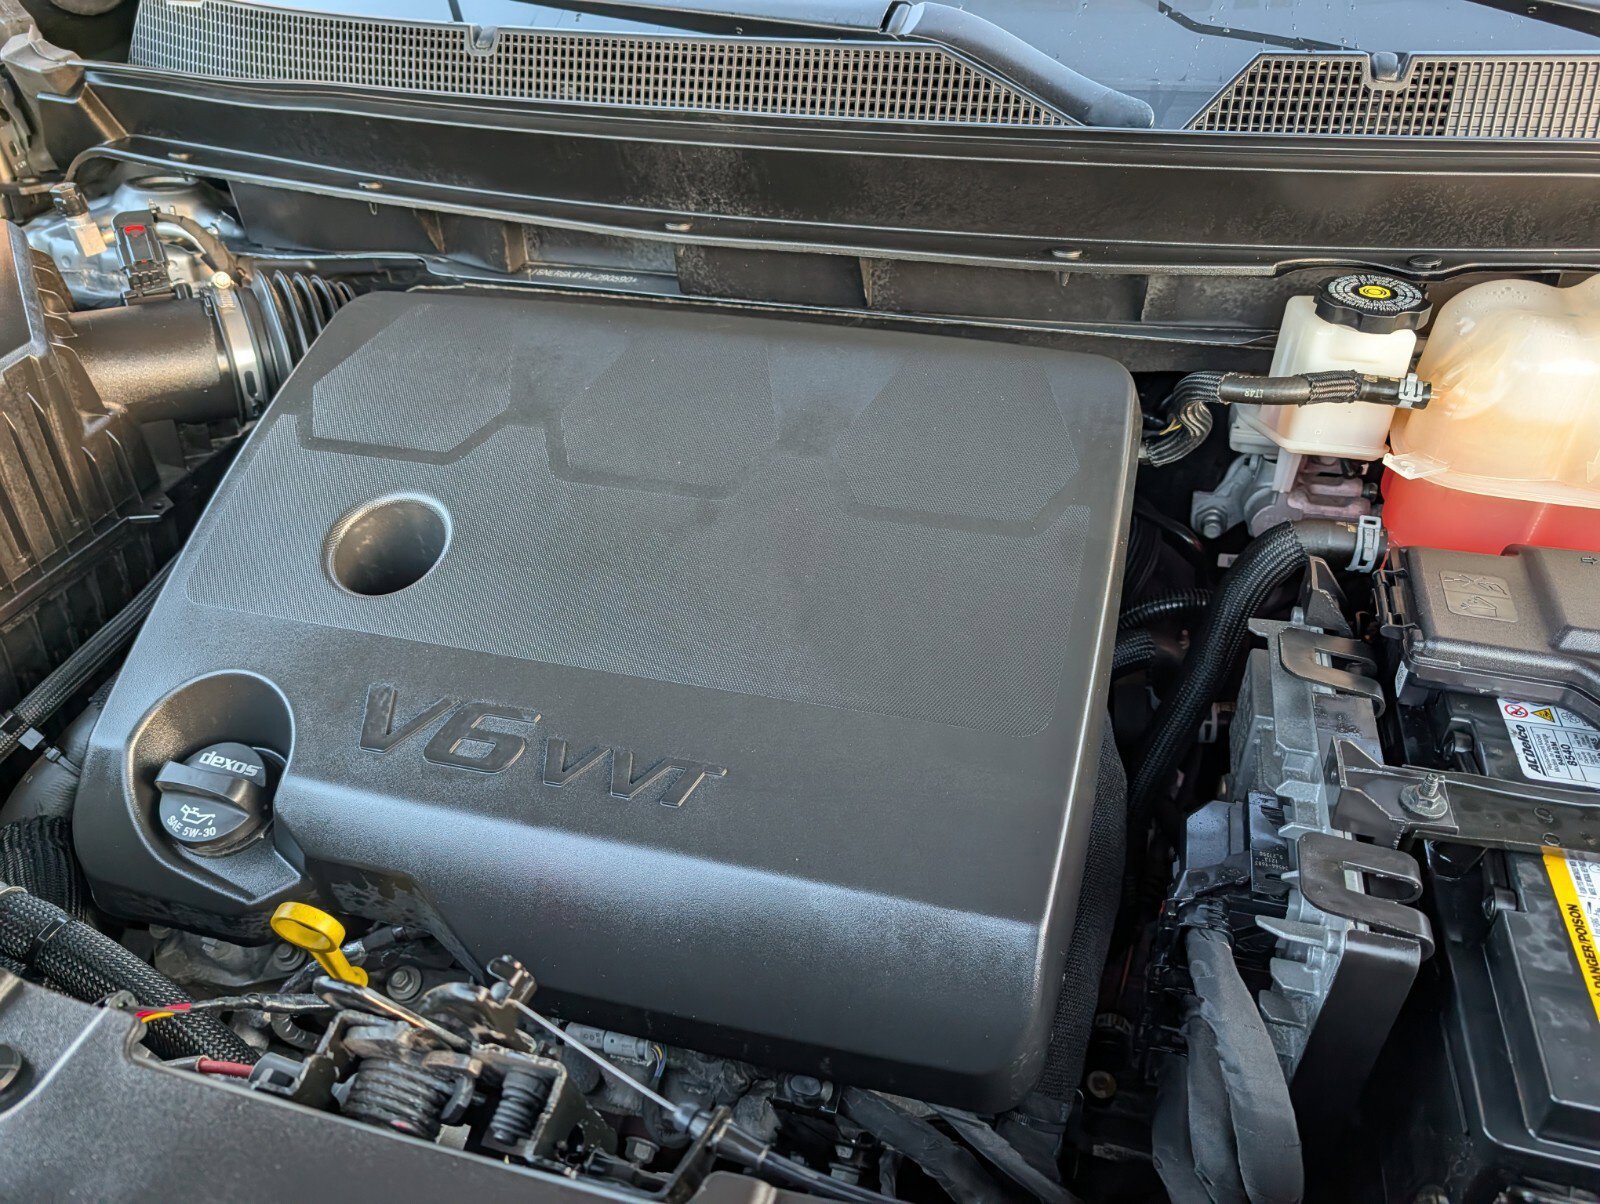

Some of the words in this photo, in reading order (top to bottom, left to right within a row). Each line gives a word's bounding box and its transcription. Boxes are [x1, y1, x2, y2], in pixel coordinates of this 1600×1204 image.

[359, 682, 541, 774] V6
[542, 734, 727, 807] VVT
[1516, 724, 1541, 774] ACDelco
[1561, 744, 1578, 767] 8540
[199, 751, 262, 776] dexos
[167, 815, 184, 832] SAE
[182, 826, 217, 838] 5W-30
